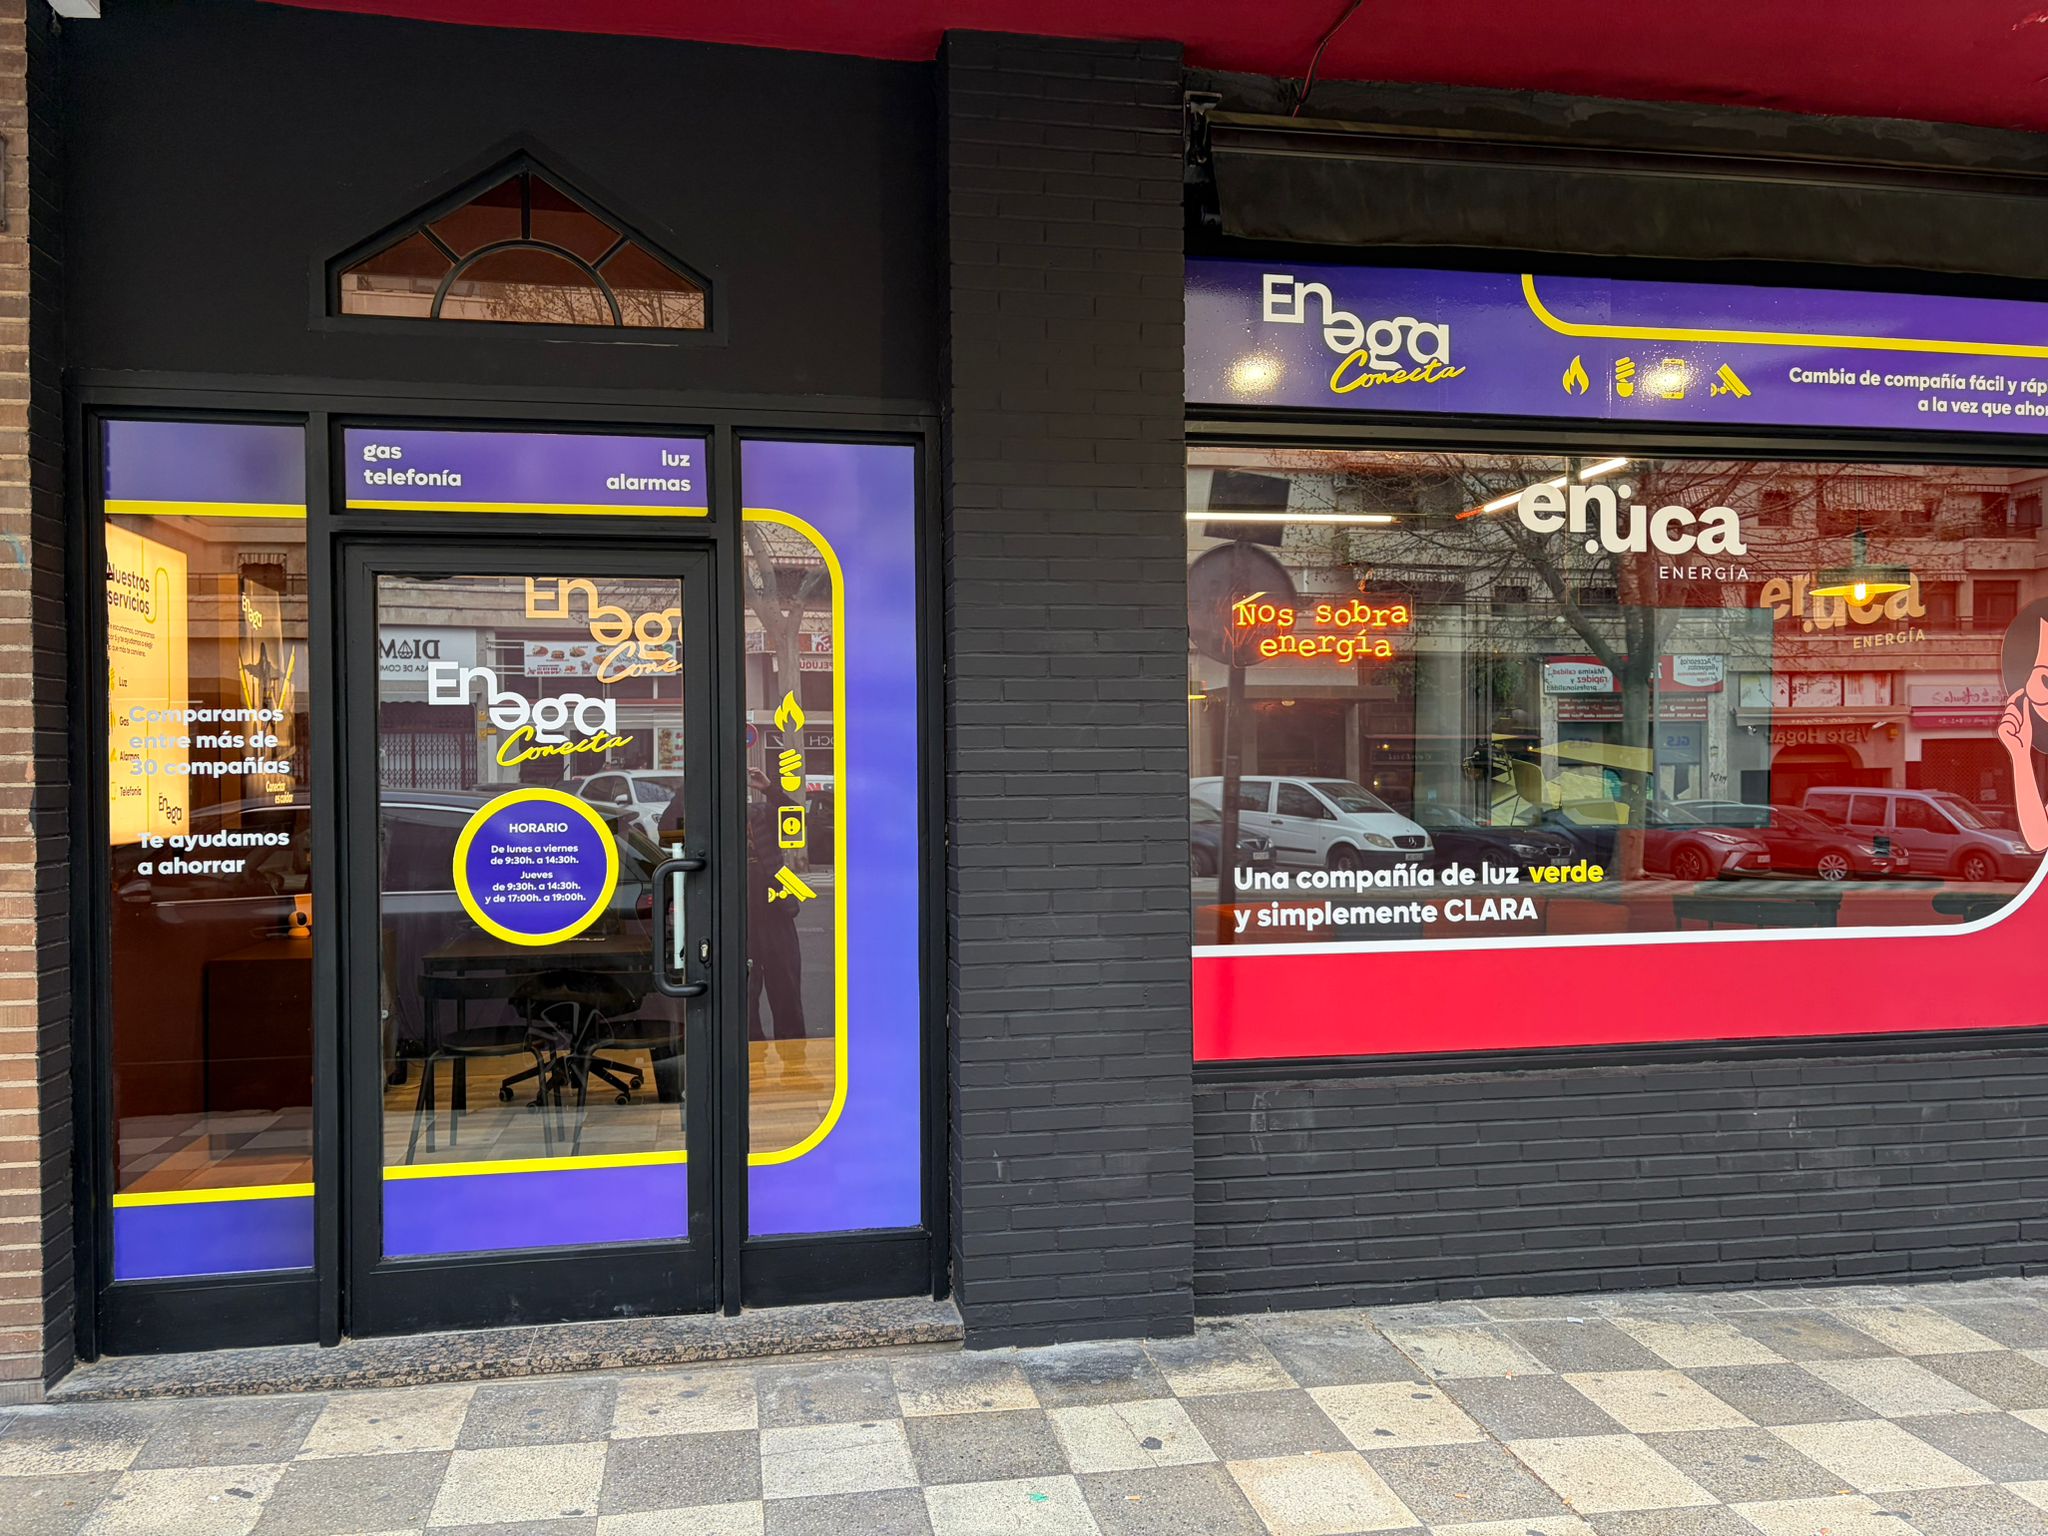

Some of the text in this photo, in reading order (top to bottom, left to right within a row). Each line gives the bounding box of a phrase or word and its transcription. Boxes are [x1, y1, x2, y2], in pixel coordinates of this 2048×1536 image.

[1329, 349, 1466, 394] Conecta
[1789, 367, 2048, 396] Cambia de compañía fácil y ráp
[1918, 400, 1929, 412] a
[1932, 397, 1948, 412] la
[1951, 401, 1978, 414] vez
[1981, 402, 2012, 418] que
[363, 444, 402, 462] gas
[662, 450, 691, 467] luz
[363, 468, 462, 487] telefonía
[606, 473, 692, 492] alarmas
[1659, 565, 1749, 581] ENERGÍA
[107, 589, 150, 615] servicios
[1236, 599, 1409, 628] Nos sobra
[1260, 629, 1393, 663] energía
[1853, 628, 1927, 650] ENERGÍA
[129, 705, 284, 726] Comparamos
[129, 730, 278, 749] entre más de
[496, 725, 634, 767] Conecta
[130, 757, 290, 779] 30 compañías
[509, 823, 568, 833] HORARIO
[138, 830, 290, 852] Te ayudamos
[491, 845, 505, 854] De
[506, 844, 533, 854] lunes
[543, 844, 579, 853] viernes
[137, 857, 246, 875] a ahorrar
[490, 856, 503, 865] de
[505, 856, 535, 865] 9:30h.
[545, 855, 579, 864] 14:30h.
[520, 871, 553, 880] Jueves
[1234, 859, 1604, 893] Una compañía de luz verde
[492, 883, 505, 892] de
[507, 882, 537, 891] 9:30h.
[547, 881, 581, 890] 14:30h.
[485, 896, 492, 905] y
[493, 894, 506, 903] de
[508, 894, 542, 903] 17:00h.
[551, 893, 586, 902] 19:00h.
[1234, 898, 1538, 933] y simplemente CLARA
